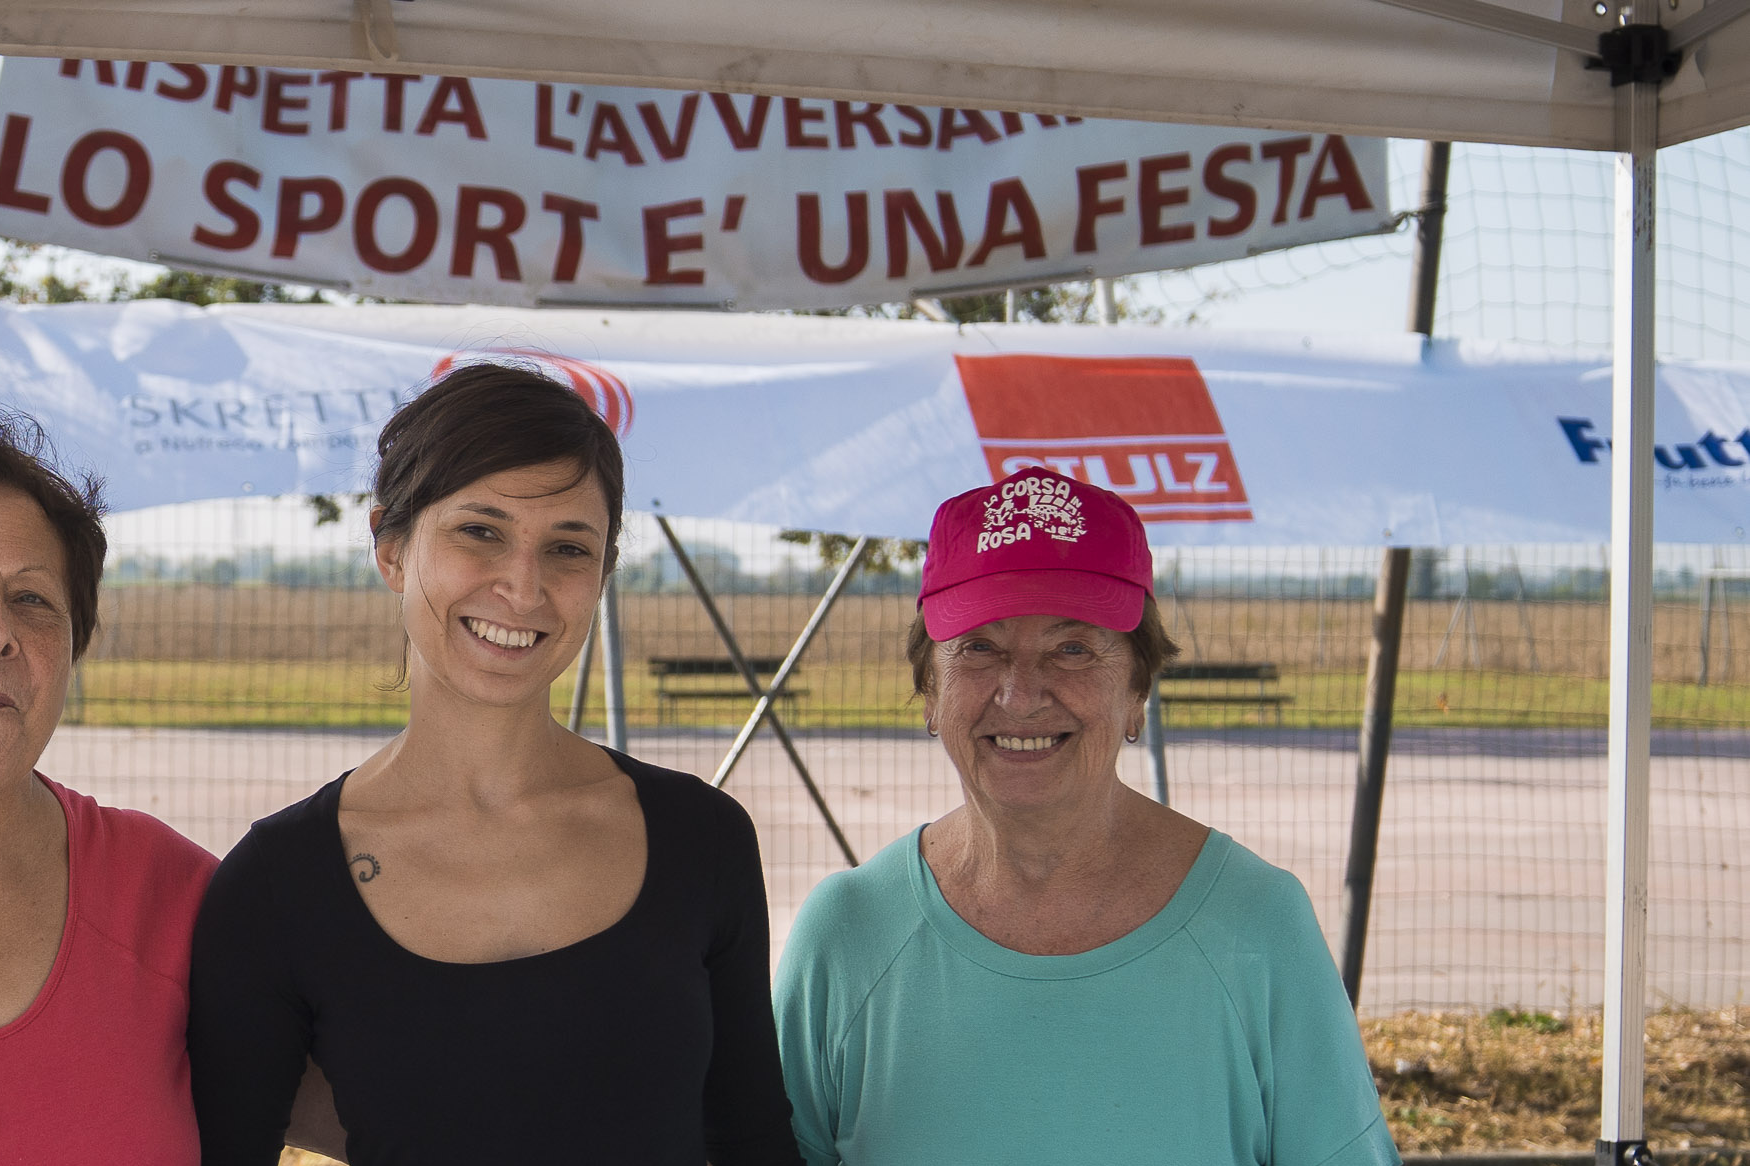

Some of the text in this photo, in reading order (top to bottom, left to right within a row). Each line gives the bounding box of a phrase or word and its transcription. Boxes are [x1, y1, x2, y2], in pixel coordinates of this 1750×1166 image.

[192, 160, 600, 286] SPORT
[641, 195, 746, 287] E'
[795, 176, 1048, 285] UNA
[1073, 134, 1375, 255] FESTA
[1001, 477, 1071, 500] CORSA
[976, 522, 1032, 554] ROSA
